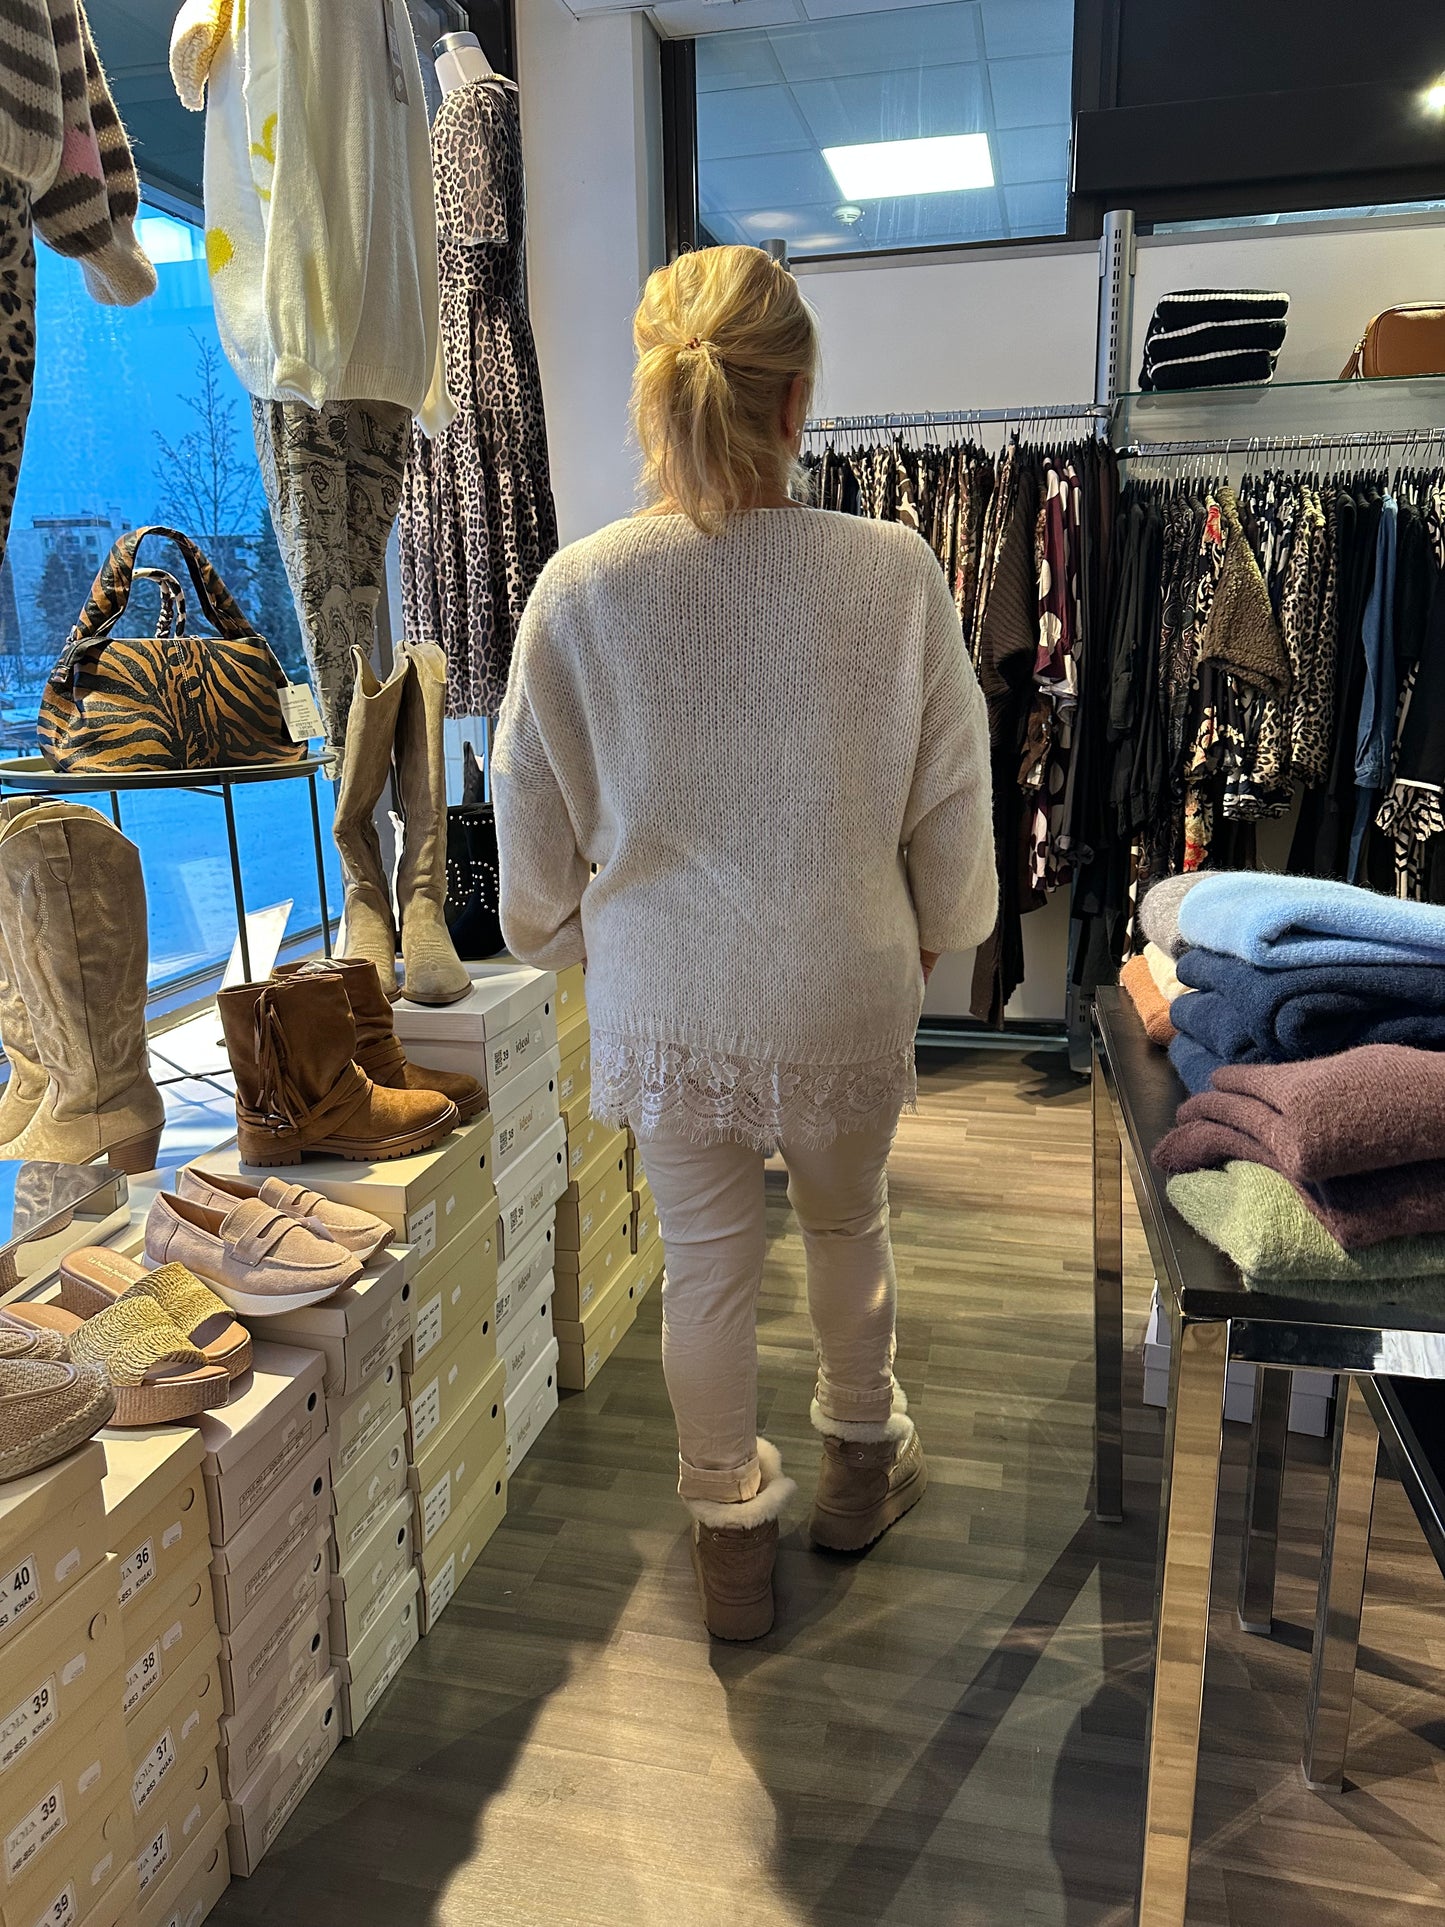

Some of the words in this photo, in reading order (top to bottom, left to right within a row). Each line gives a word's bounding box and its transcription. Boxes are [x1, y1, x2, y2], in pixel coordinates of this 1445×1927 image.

[515, 1033, 530, 1053] ideal
[530, 1186, 544, 1208] ideal
[518, 1267, 531, 1291] ideal
[512, 1345, 526, 1371] ideal
[136, 1547, 149, 1569] 36
[13, 1566, 30, 1591] 40
[136, 1568, 153, 1589] KHAKI
[14, 1590, 36, 1615] KHAKI
[142, 1651, 155, 1674] 38
[142, 1671, 158, 1692] KHAKI
[33, 1688, 49, 1714] 39
[32, 1713, 53, 1737] KHAKI
[156, 1736, 168, 1761] 37
[159, 1754, 174, 1777] KHAKI
[41, 1795, 57, 1821] 39
[40, 1818, 61, 1842] KHAKI
[152, 1832, 164, 1858] 37
[152, 1852, 168, 1875] KHAKI
[54, 1894, 69, 1920] 39
